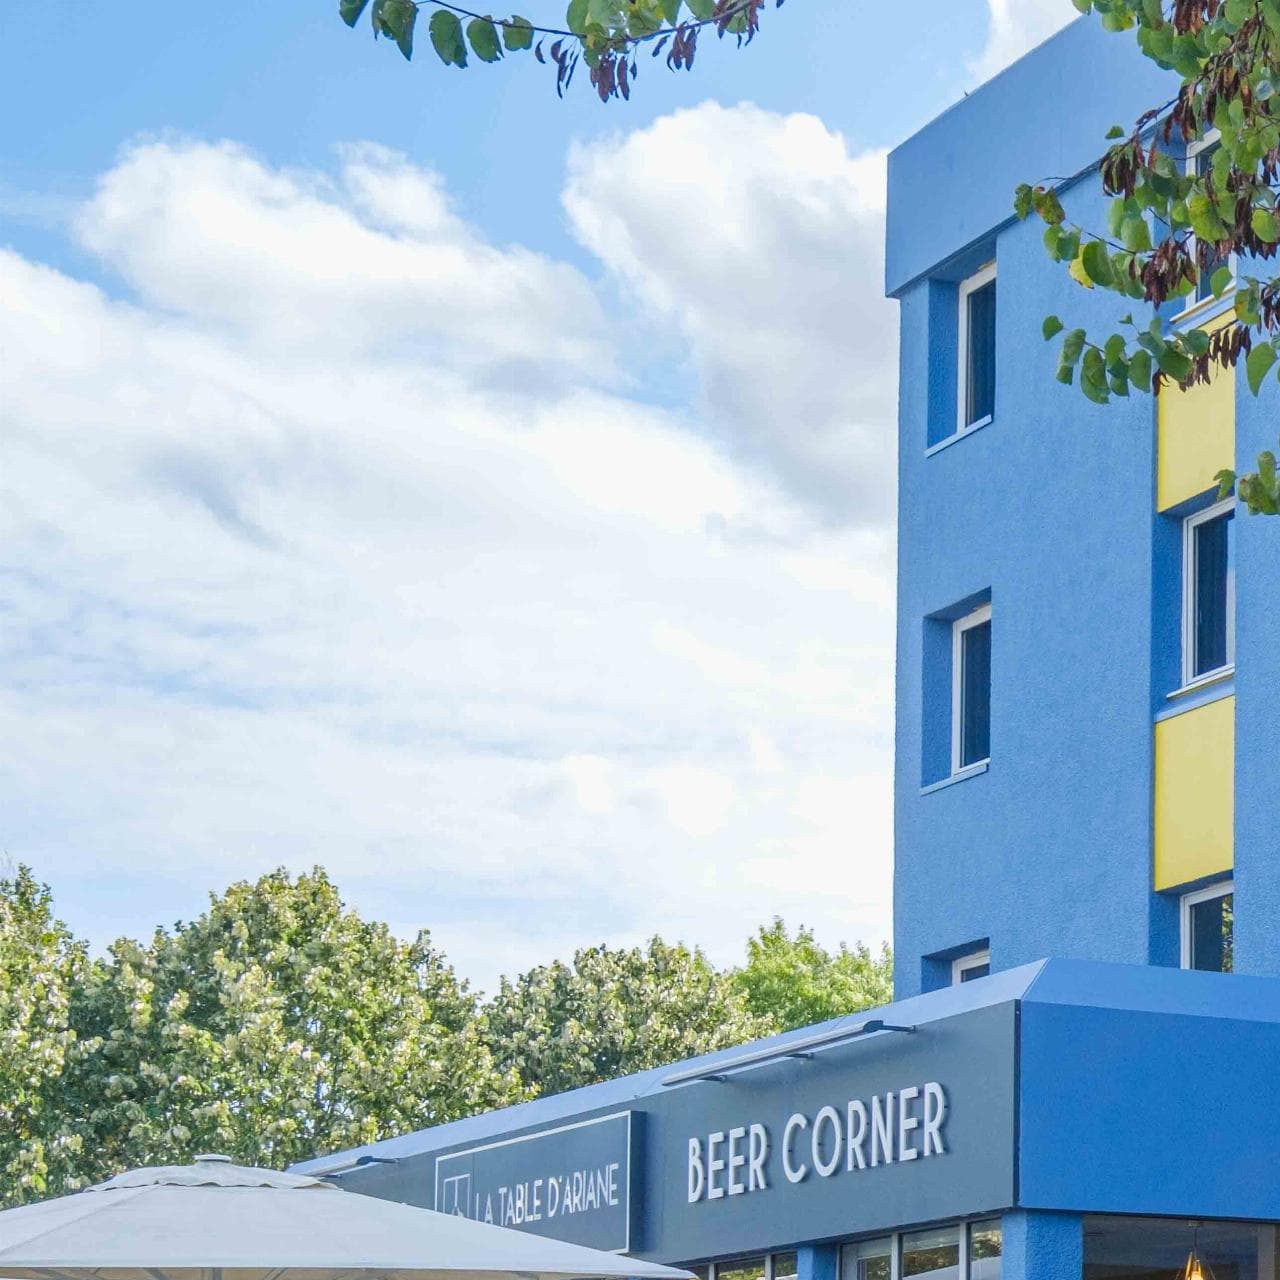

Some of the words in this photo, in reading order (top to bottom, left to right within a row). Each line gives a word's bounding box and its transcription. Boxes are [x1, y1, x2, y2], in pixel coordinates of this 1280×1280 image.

[687, 1122, 768, 1203] BEER
[782, 1081, 946, 1184] CORNER
[498, 1179, 544, 1227] TABLE
[547, 1163, 620, 1218] D'ARIANE
